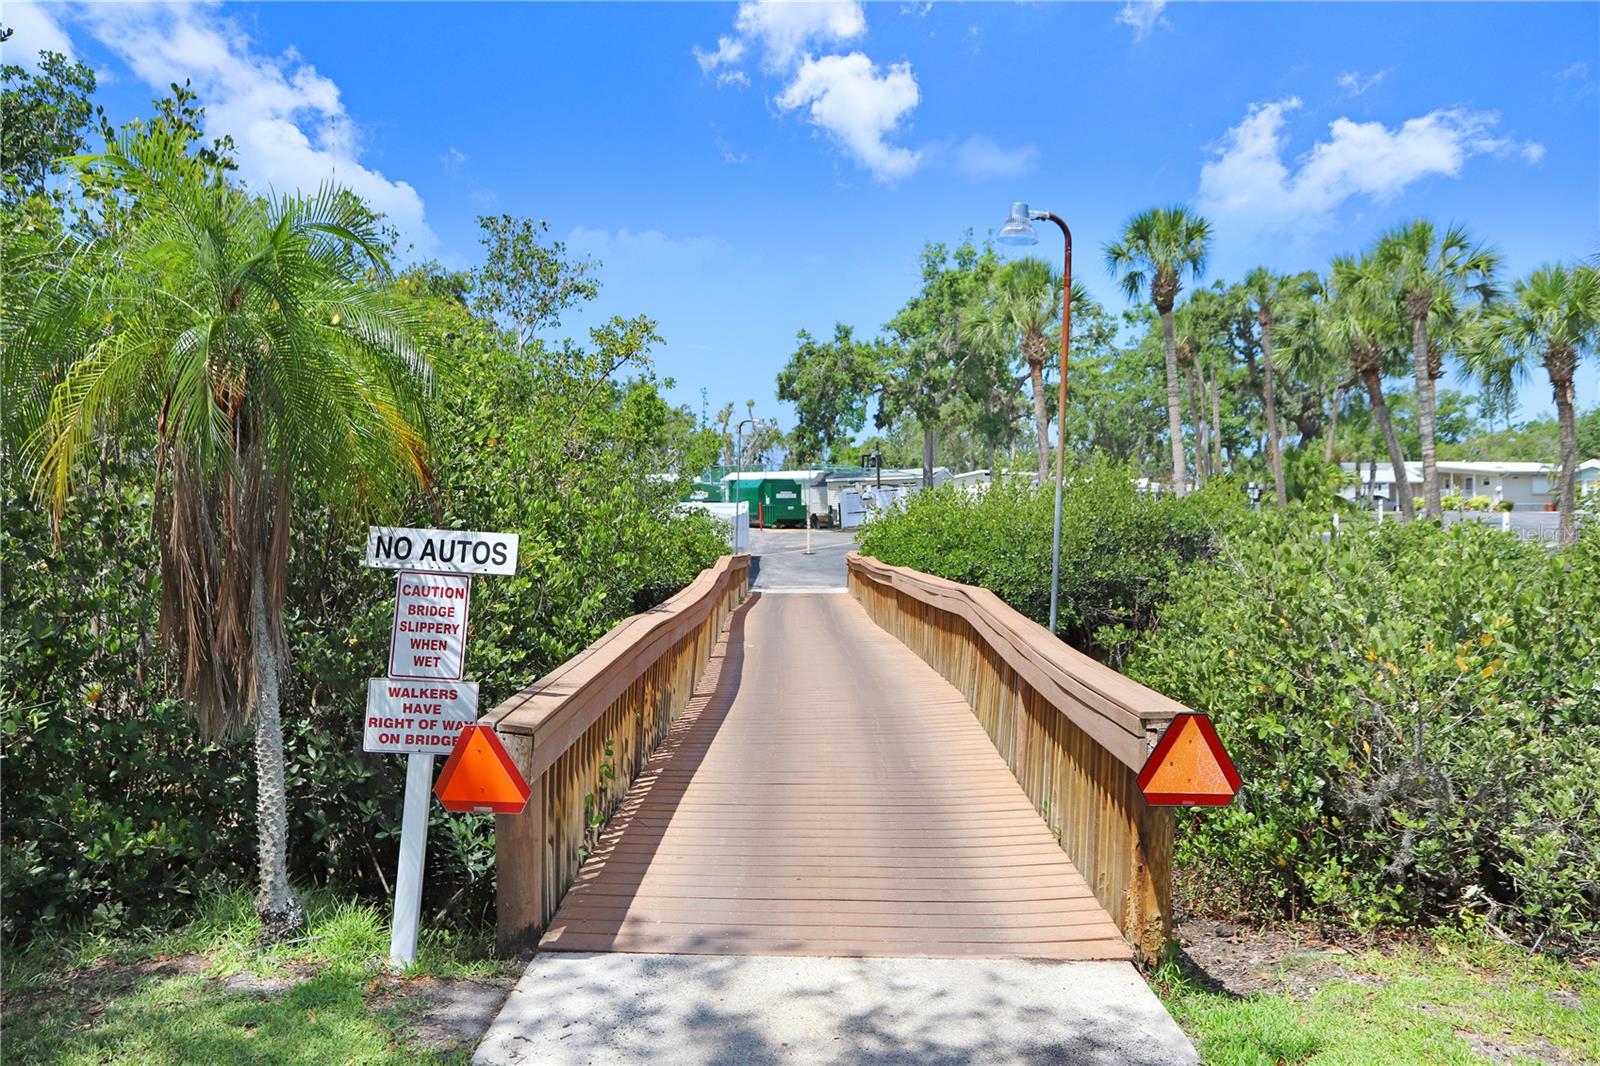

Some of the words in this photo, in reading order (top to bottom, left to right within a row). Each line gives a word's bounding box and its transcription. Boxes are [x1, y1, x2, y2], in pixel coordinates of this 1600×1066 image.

[375, 535, 412, 560] NO
[420, 538, 508, 566] AUTOS
[402, 584, 465, 600] CAUTION
[408, 604, 455, 618] BRIDGE
[400, 621, 460, 635] SLIPPERY
[410, 638, 447, 651] WHEN
[413, 656, 441, 668] WET
[388, 687, 458, 700] WALKERS
[403, 703, 442, 715] HAVE
[368, 717, 414, 730] RIGHT
[418, 718, 438, 730] OF
[379, 733, 401, 745] ON
[405, 735, 459, 747] BRIDGE
